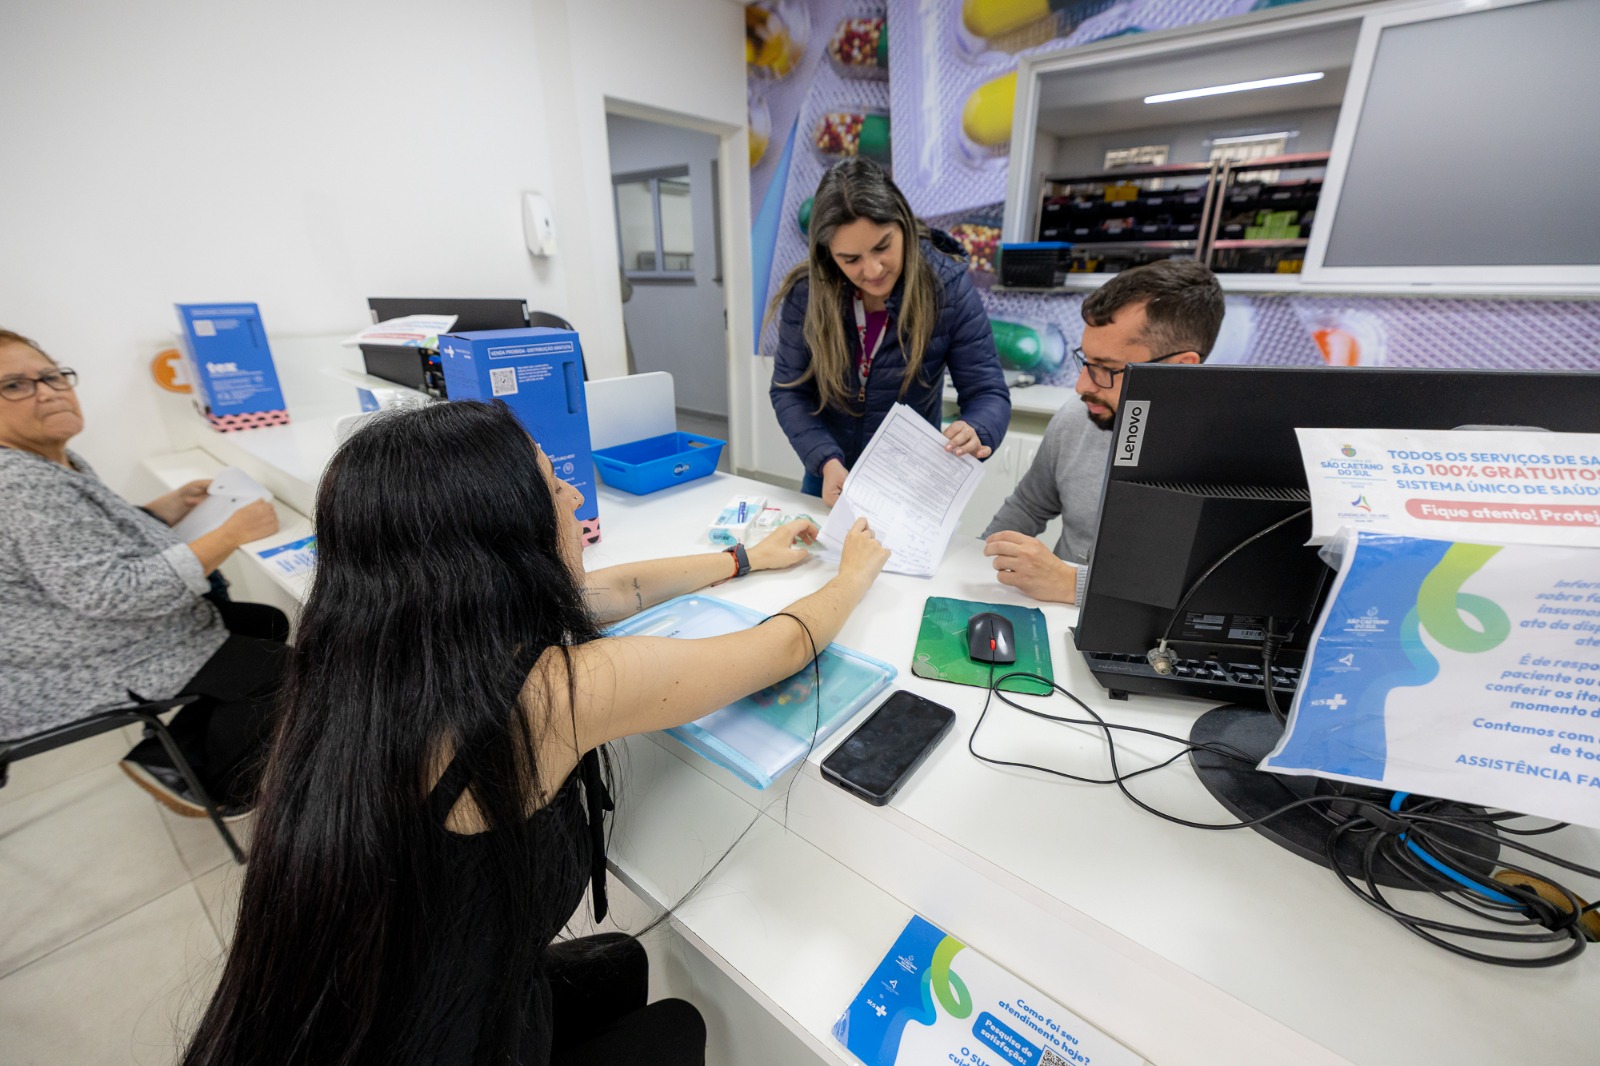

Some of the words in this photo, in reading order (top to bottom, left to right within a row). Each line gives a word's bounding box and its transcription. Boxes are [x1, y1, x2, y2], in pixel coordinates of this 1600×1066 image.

[1120, 406, 1142, 461] Lenovo
[1320, 461, 1339, 469] SÃO
[1341, 462, 1383, 471] CAETANO
[1387, 450, 1443, 461] TODOS
[1445, 452, 1468, 462] OS
[1470, 453, 1551, 466] SERVIÇOS
[1553, 455, 1577, 465] DE
[1392, 463, 1425, 475] SÃO
[1426, 463, 1478, 477] 100%
[1396, 480, 1466, 492] SISTEMA
[1467, 480, 1520, 494] ÚNICO
[1523, 485, 1548, 495] DE
[1550, 483, 1600, 496] SAÚD
[1420, 504, 1469, 520] Fique
[1471, 507, 1538, 521] atento!
[1535, 592, 1583, 602] sobre
[1519, 619, 1547, 628] ato
[1549, 620, 1570, 630] da
[1519, 653, 1531, 665] É
[1532, 657, 1551, 666] de
[1500, 670, 1572, 683] paciente
[1574, 677, 1595, 686] ou
[1485, 683, 1552, 697] conferir
[1554, 690, 1573, 699] os
[1575, 690, 1600, 702] ite
[1510, 700, 1587, 717] momento
[1472, 717, 1555, 737] Contamos
[1558, 731, 1594, 743] com
[1549, 743, 1571, 756] de
[1455, 754, 1572, 783] ASSISTÊNCIA
[1017, 999, 1044, 1022] Como
[1046, 1018, 1061, 1033] foi
[1061, 1030, 1079, 1045] seu
[985, 1019, 1022, 1049] Pesquisa
[1021, 1046, 1033, 1058] de
[998, 1000, 1060, 1046] atendimento
[1061, 1042, 1091, 1066] hoje?
[980, 1028, 1027, 1066] satisfação:
[961, 1047, 970, 1056] O
[970, 1054, 990, 1066] SU
